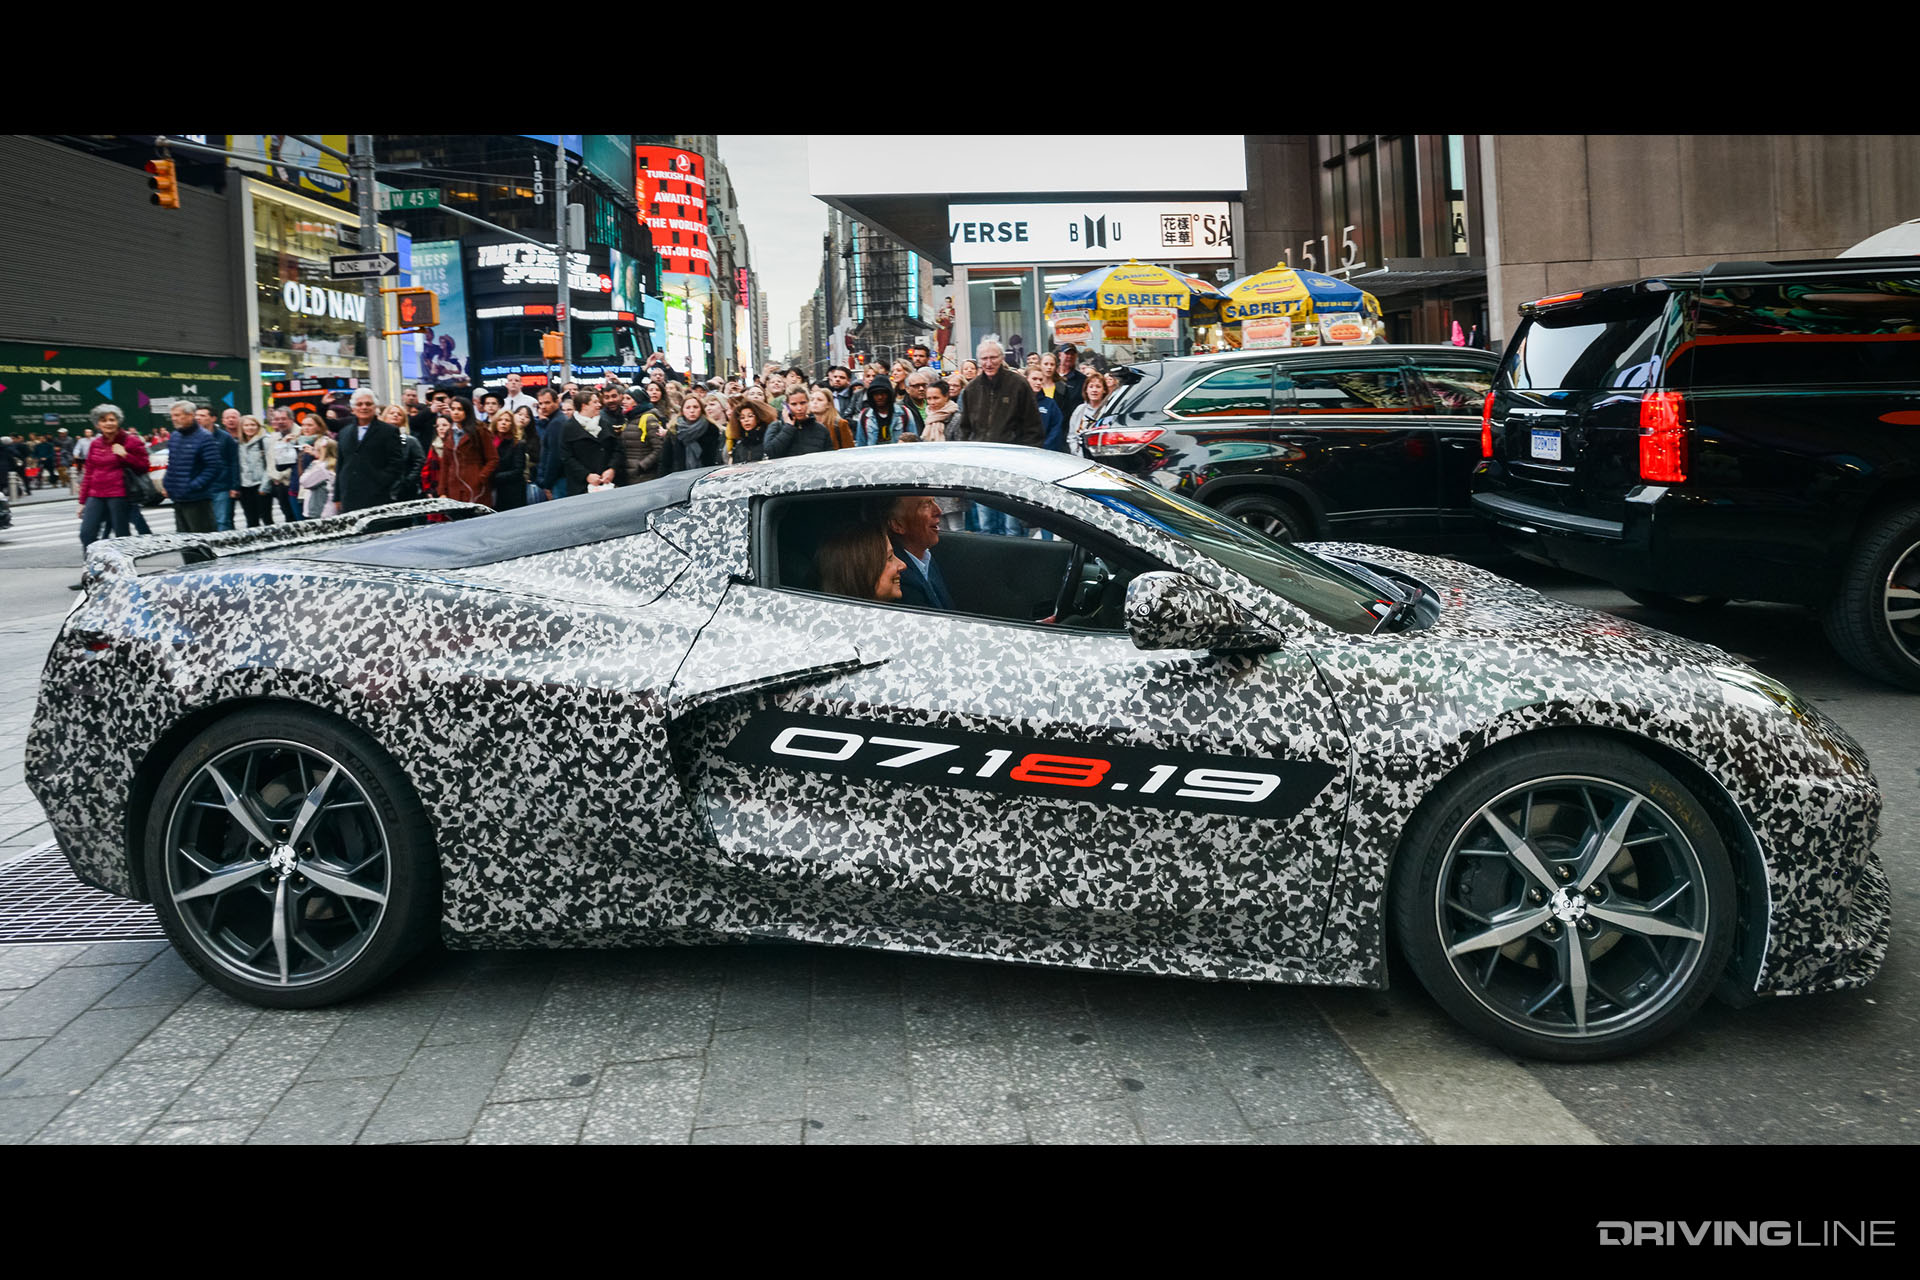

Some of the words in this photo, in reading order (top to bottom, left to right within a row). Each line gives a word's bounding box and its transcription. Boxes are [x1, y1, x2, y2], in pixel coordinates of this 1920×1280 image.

[534, 160, 545, 205] 1500
[645, 169, 684, 181] TURKISH
[391, 193, 404, 207] W
[409, 192, 425, 206] 45
[654, 191, 691, 205] AWAITS
[645, 217, 668, 229] THE
[950, 221, 1029, 243] VERSE
[1069, 222, 1079, 242] B
[1112, 222, 1122, 241] U
[1284, 225, 1358, 271] 1515
[340, 261, 360, 272] ONE
[368, 260, 389, 270] WAY
[411, 253, 449, 268] BLESS
[415, 268, 447, 281] THIS
[283, 280, 327, 316] OLD
[327, 289, 367, 323] NAV
[1103, 293, 1185, 306] SABRETT
[1225, 300, 1303, 319] SABRETT
[769, 727, 1281, 803] 07.18.19
